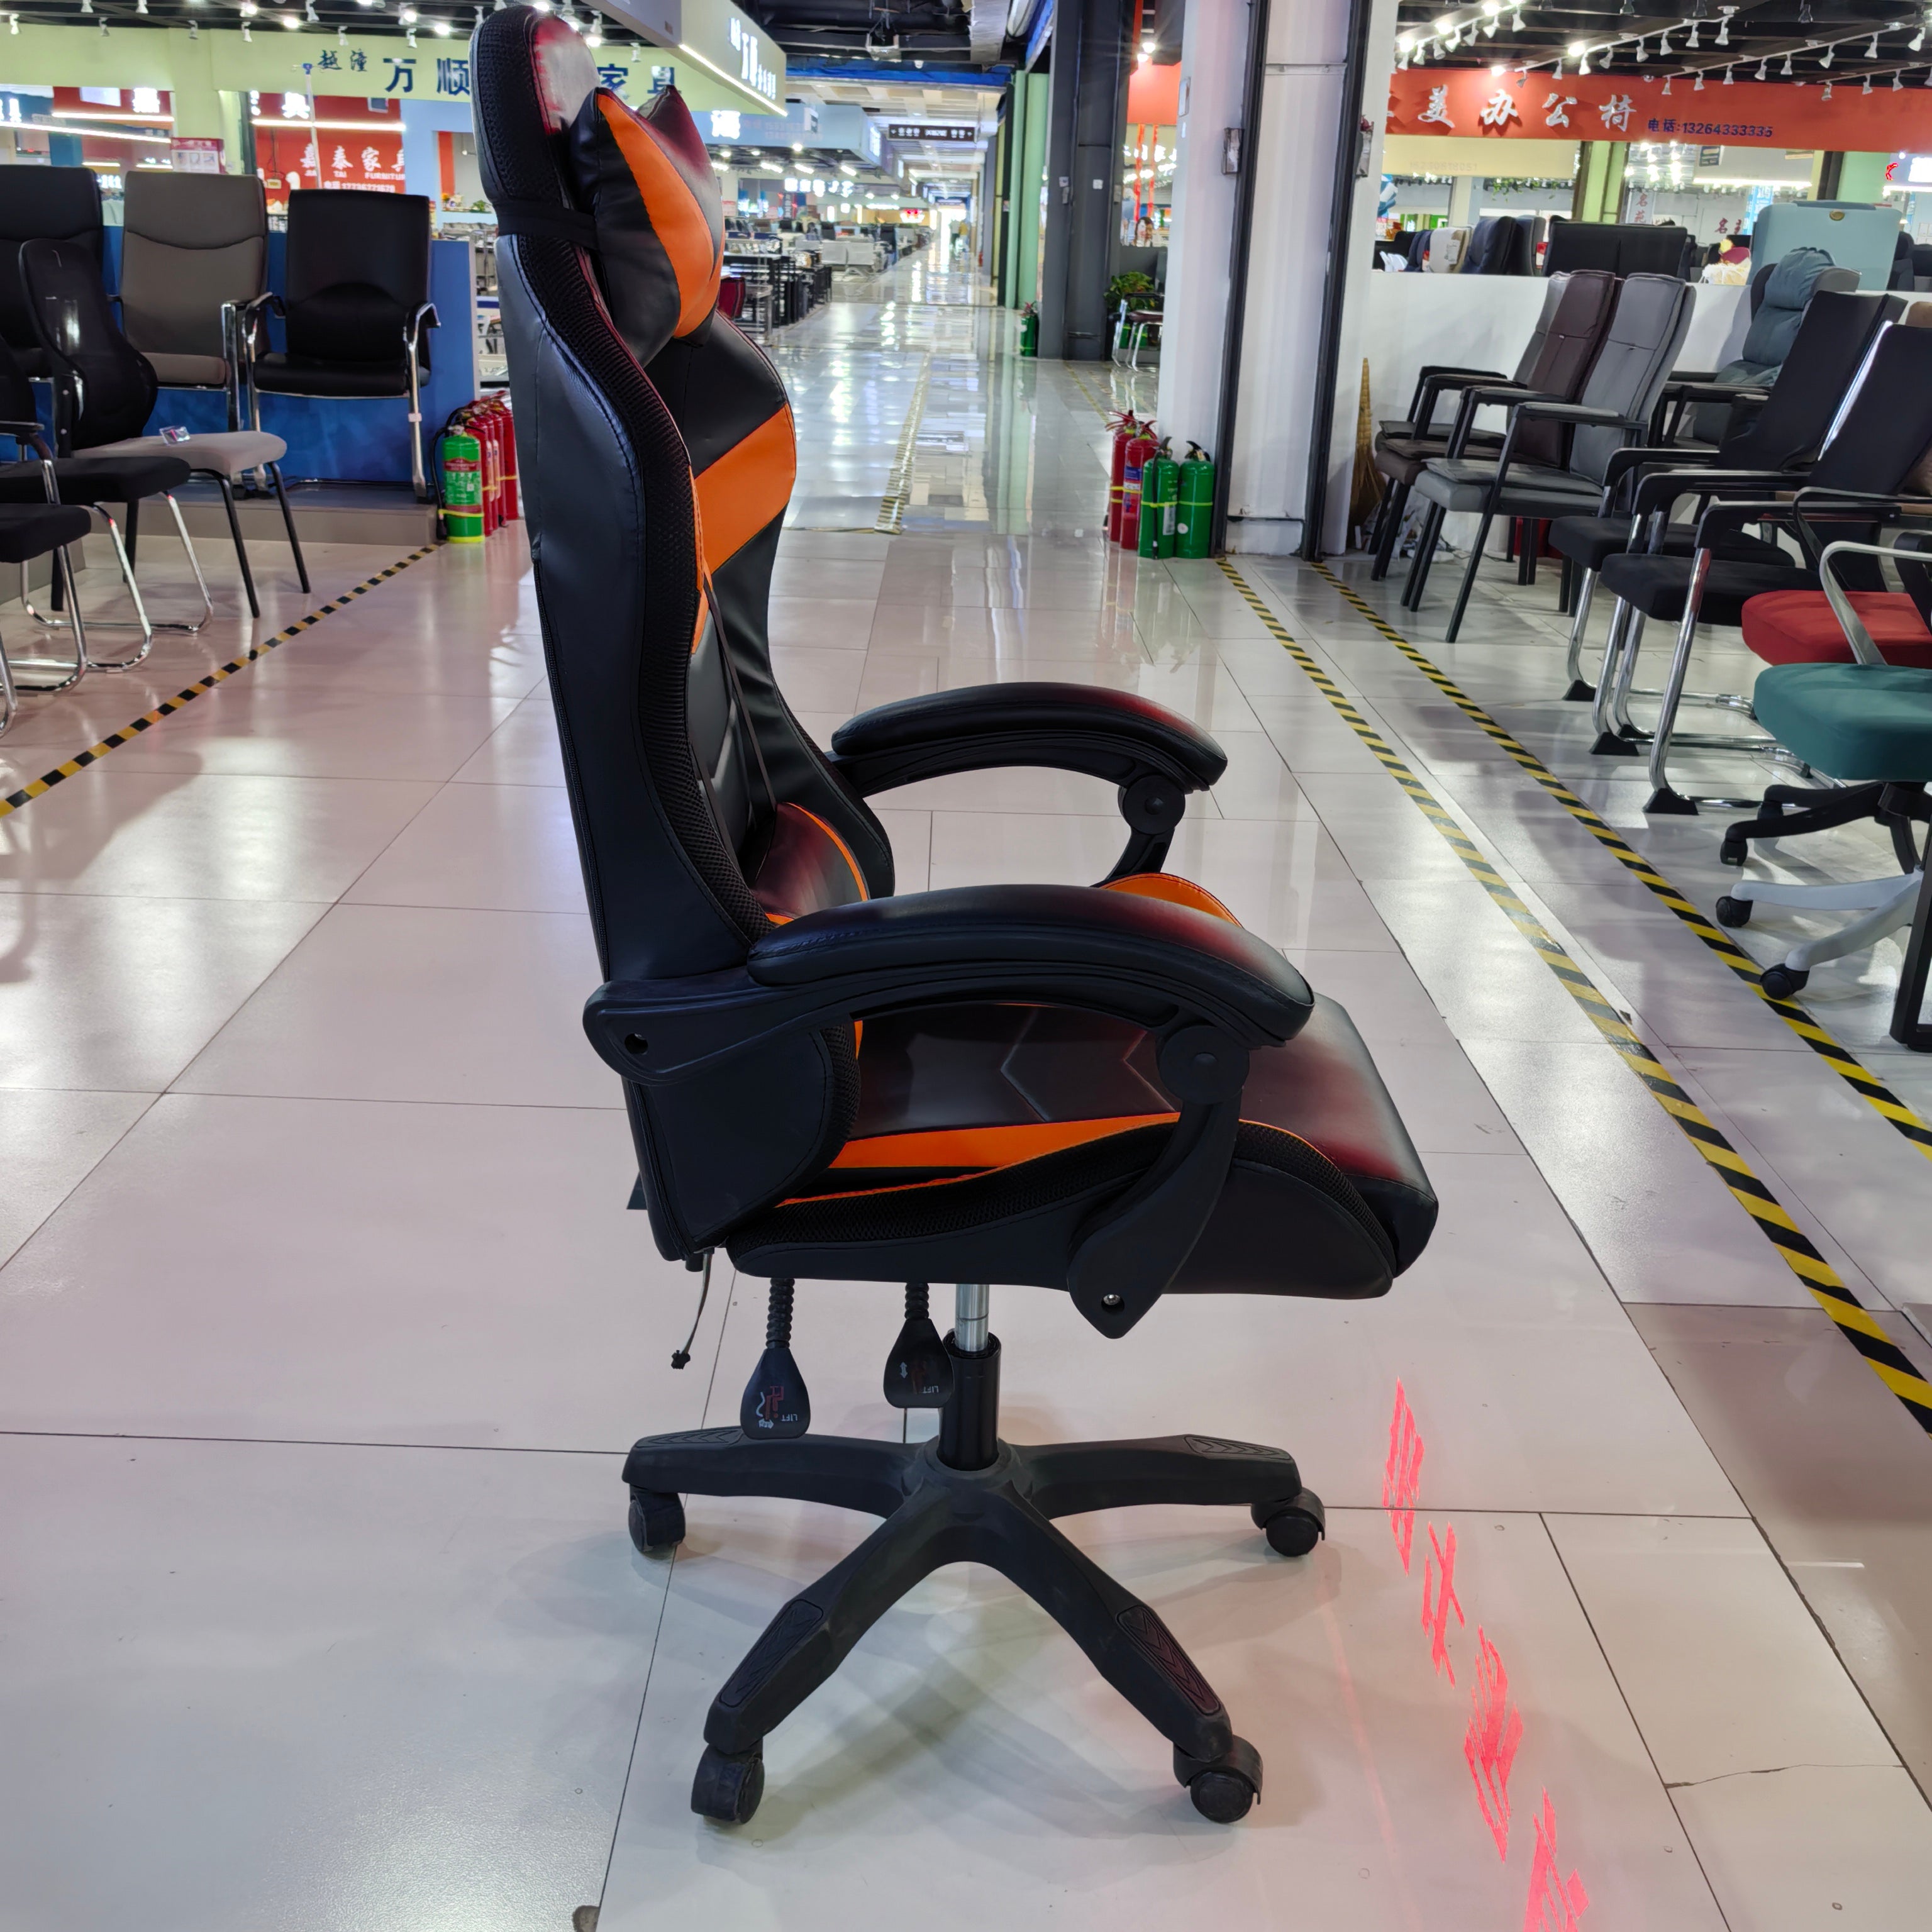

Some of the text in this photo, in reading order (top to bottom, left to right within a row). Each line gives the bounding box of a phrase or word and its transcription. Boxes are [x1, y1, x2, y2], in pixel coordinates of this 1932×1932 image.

[382, 58, 470, 96] 万顺
[597, 64, 682, 100] 家具
[1386, 84, 1636, 131] 美办公椅
[922, 1385, 940, 1394] LIFT
[781, 1413, 798, 1422] LIFT
